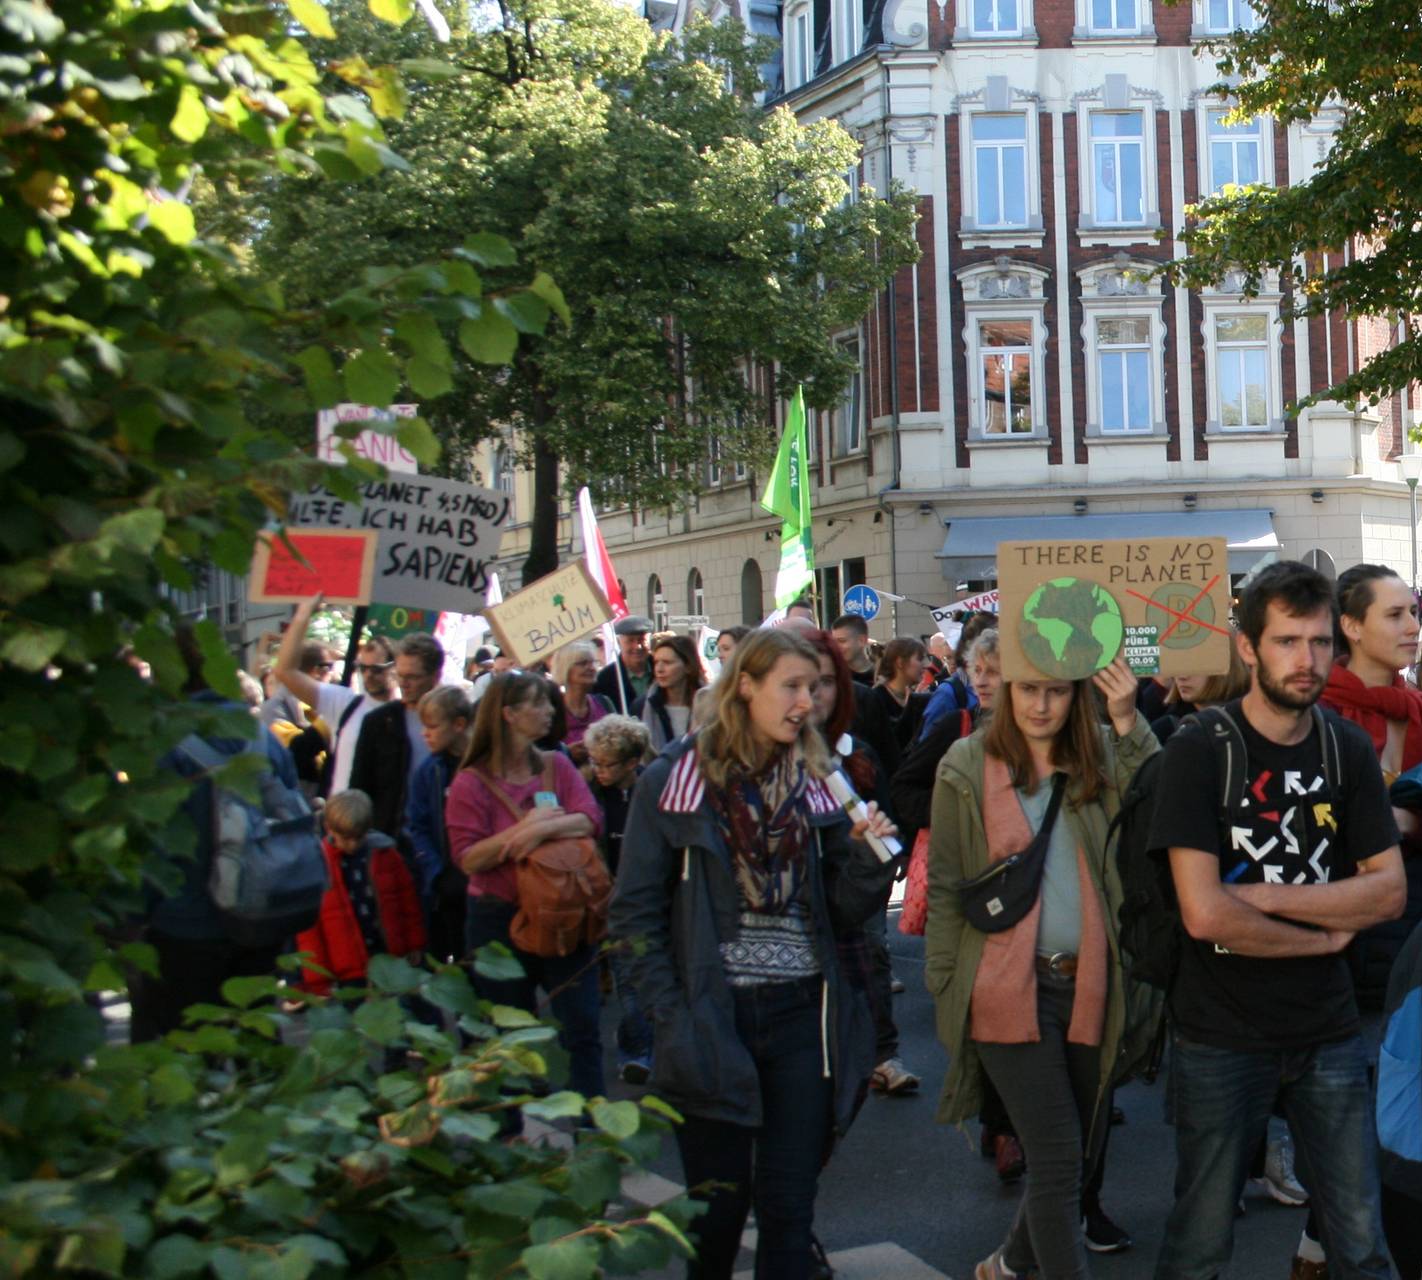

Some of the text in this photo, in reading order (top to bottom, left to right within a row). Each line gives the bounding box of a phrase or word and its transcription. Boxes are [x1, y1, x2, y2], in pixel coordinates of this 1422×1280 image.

[361, 507, 408, 531] ICH
[417, 514, 479, 547] HAB
[1014, 543, 1214, 565] THERE IS NO
[1109, 562, 1213, 583] PLANET
[524, 604, 595, 653] BAUM
[1125, 626, 1157, 635] 10.000
[1125, 635, 1149, 646] FÜRS
